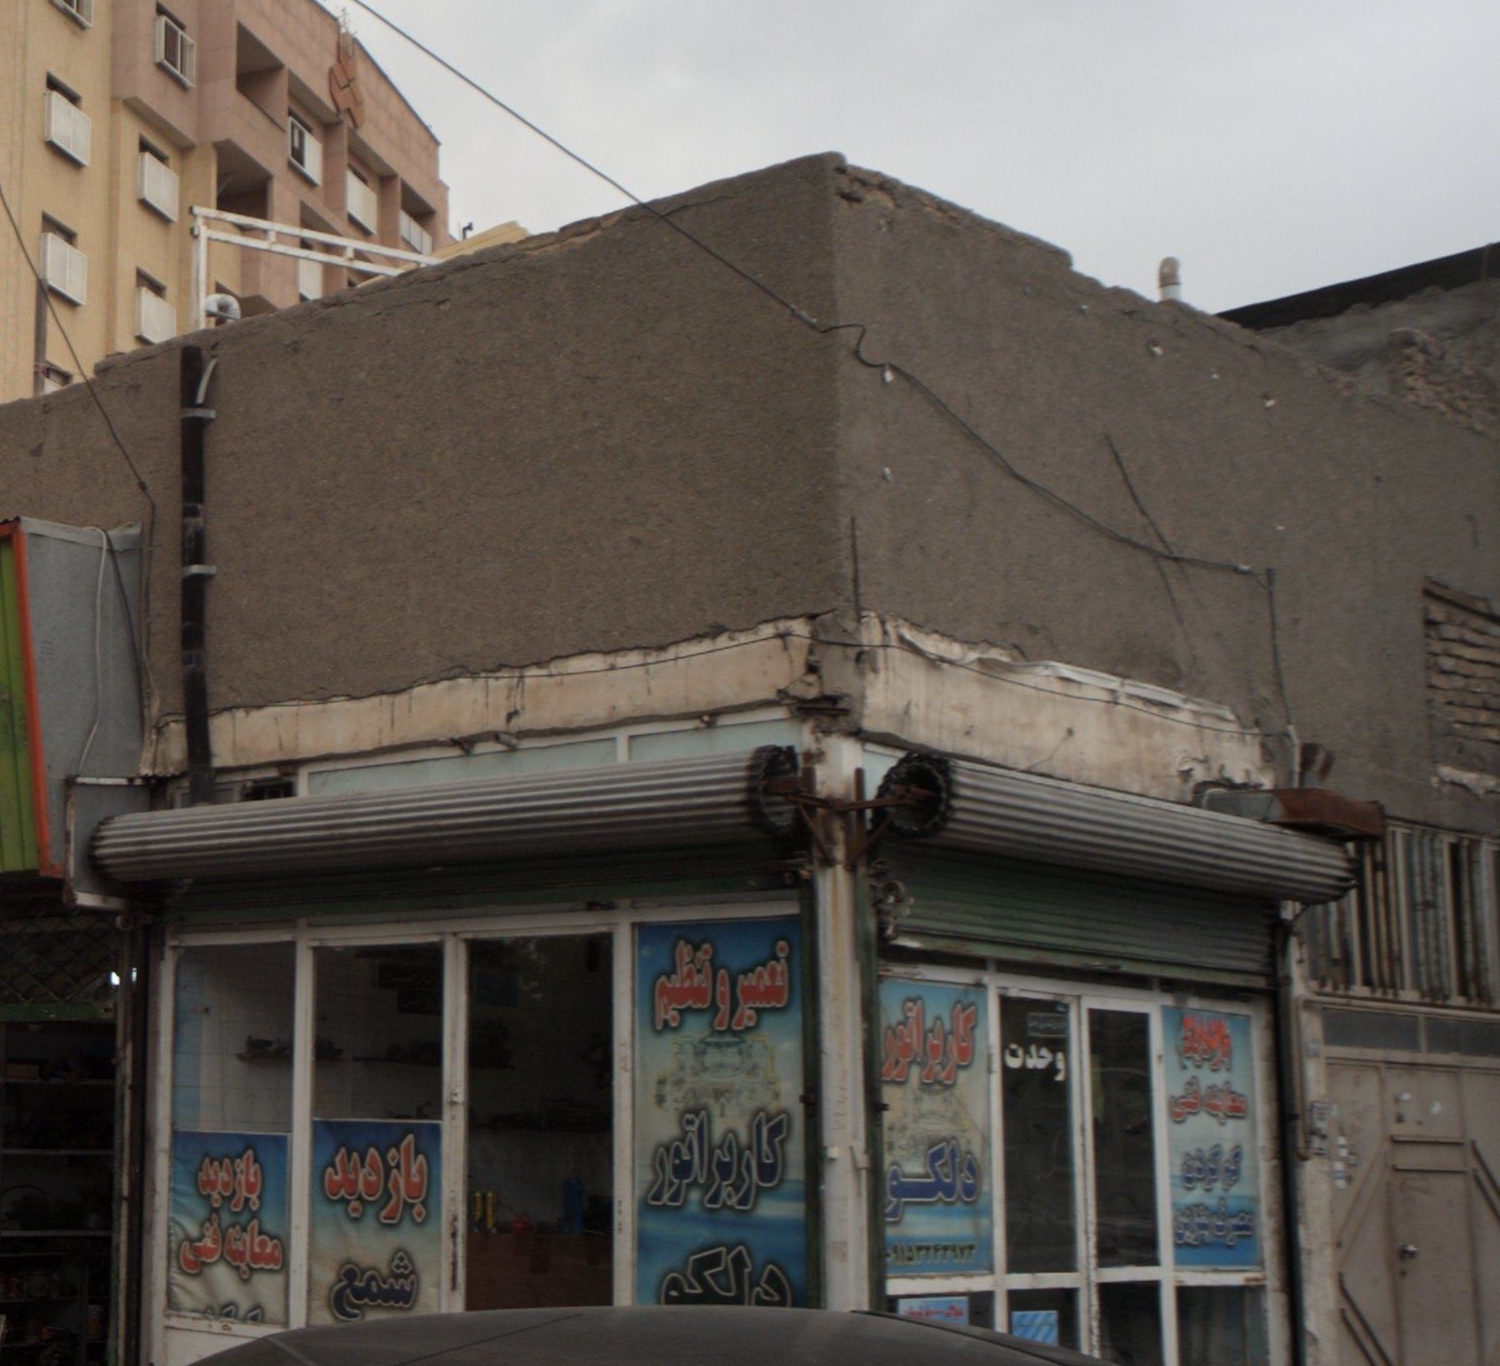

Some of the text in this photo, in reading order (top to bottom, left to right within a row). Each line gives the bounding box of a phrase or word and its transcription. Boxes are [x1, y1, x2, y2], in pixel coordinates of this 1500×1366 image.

[654, 941, 791, 1029] تعمیر و تنظیم
[881, 998, 976, 1087] کاربراتور
[1004, 1043, 1066, 1081] وحدت
[1170, 1076, 1248, 1124] معاینه فنی
[198, 1149, 263, 1213] بازدید
[324, 1134, 428, 1223] بازدید
[648, 1112, 789, 1210] کاربراتور
[885, 1142, 979, 1221] دلکو
[181, 1216, 283, 1278] معاینه فنی
[331, 1250, 420, 1321] شمع
